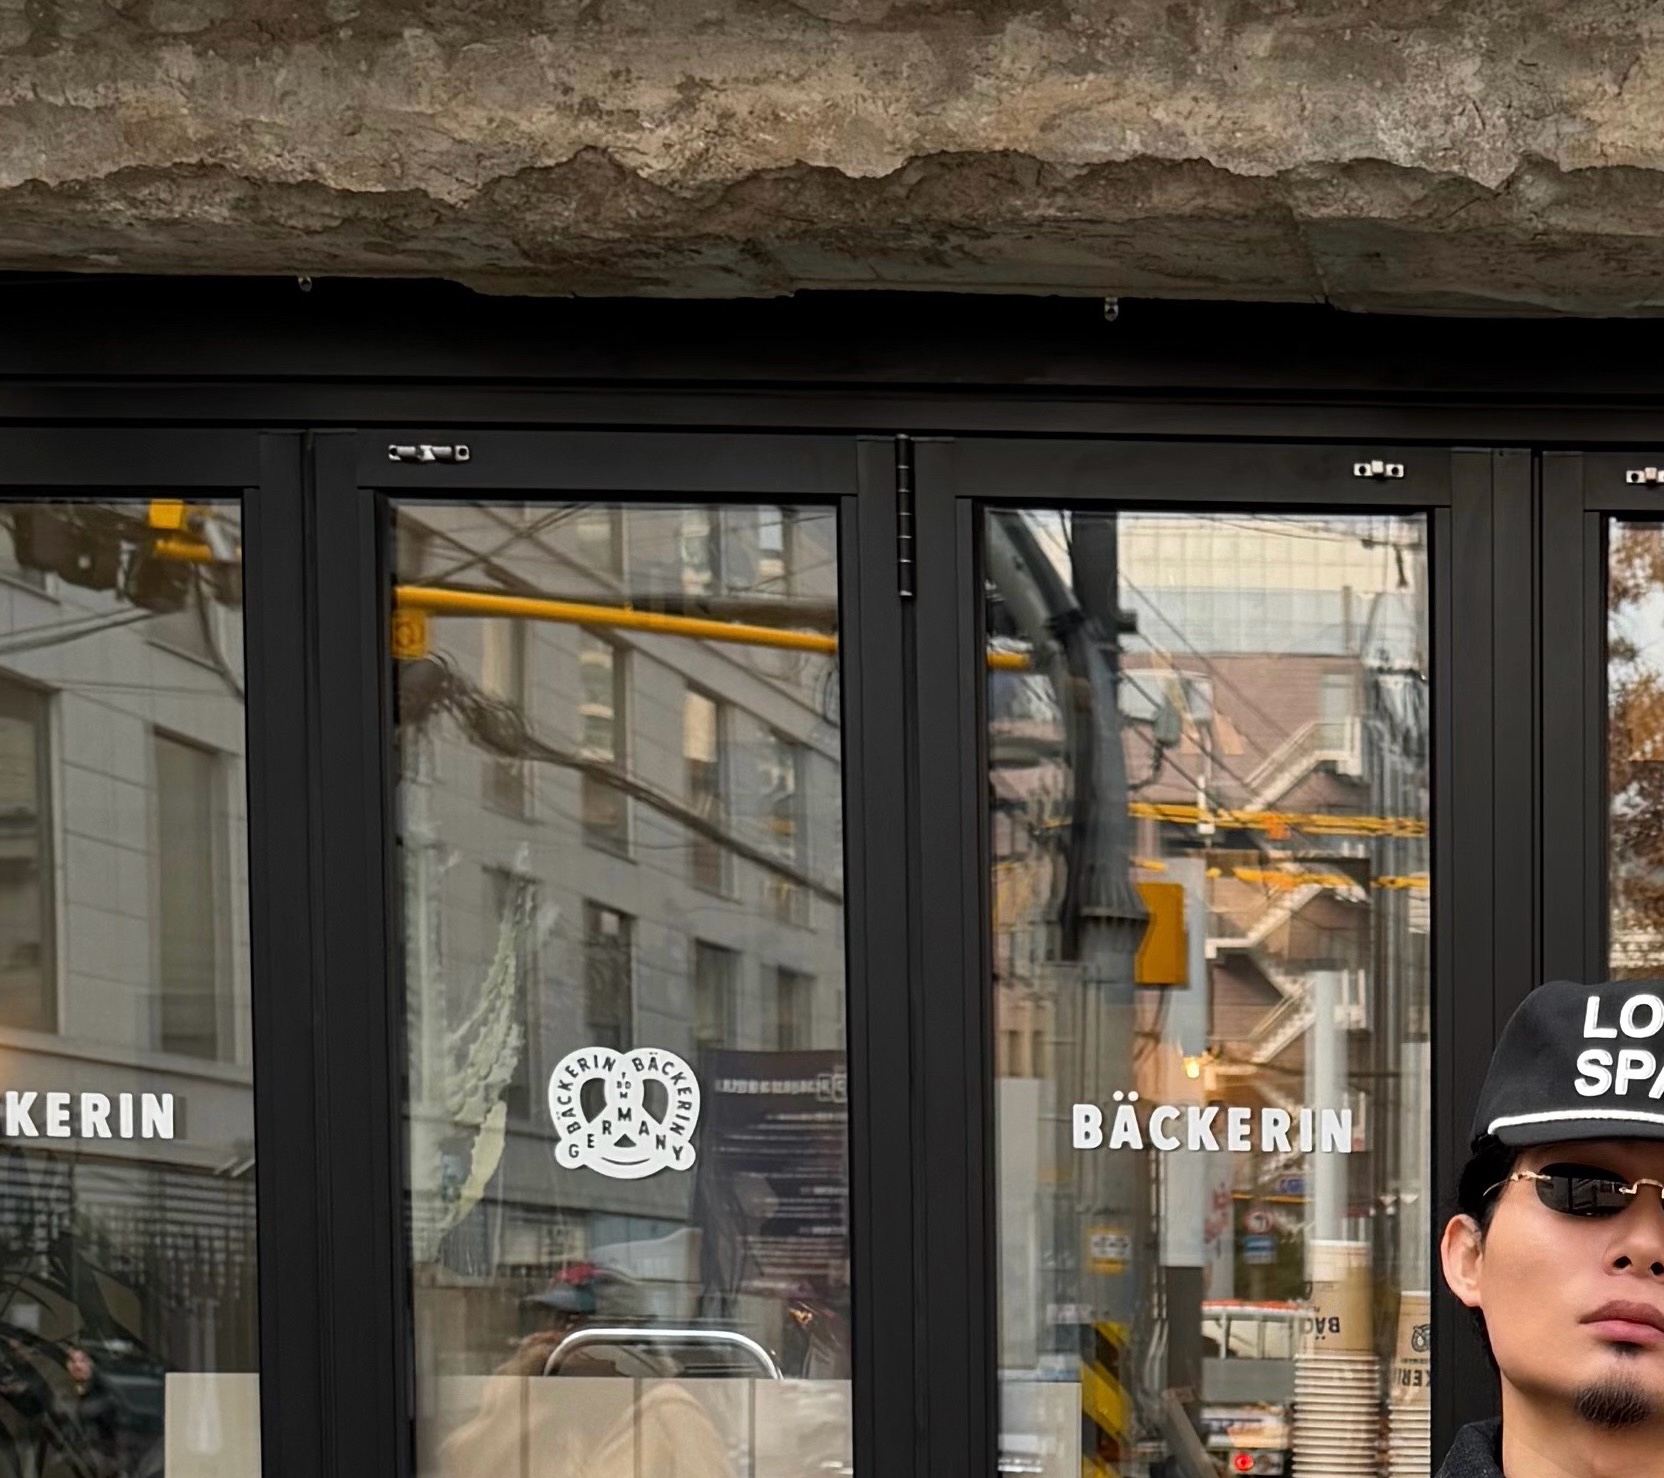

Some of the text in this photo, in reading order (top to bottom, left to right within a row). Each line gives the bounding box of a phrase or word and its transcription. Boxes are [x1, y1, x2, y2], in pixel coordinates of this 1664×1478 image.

[6, 1091, 174, 1139] KERIN
[569, 1106, 684, 1160] GERMANY
[1073, 1090, 1352, 1153] BÄCKERIN
